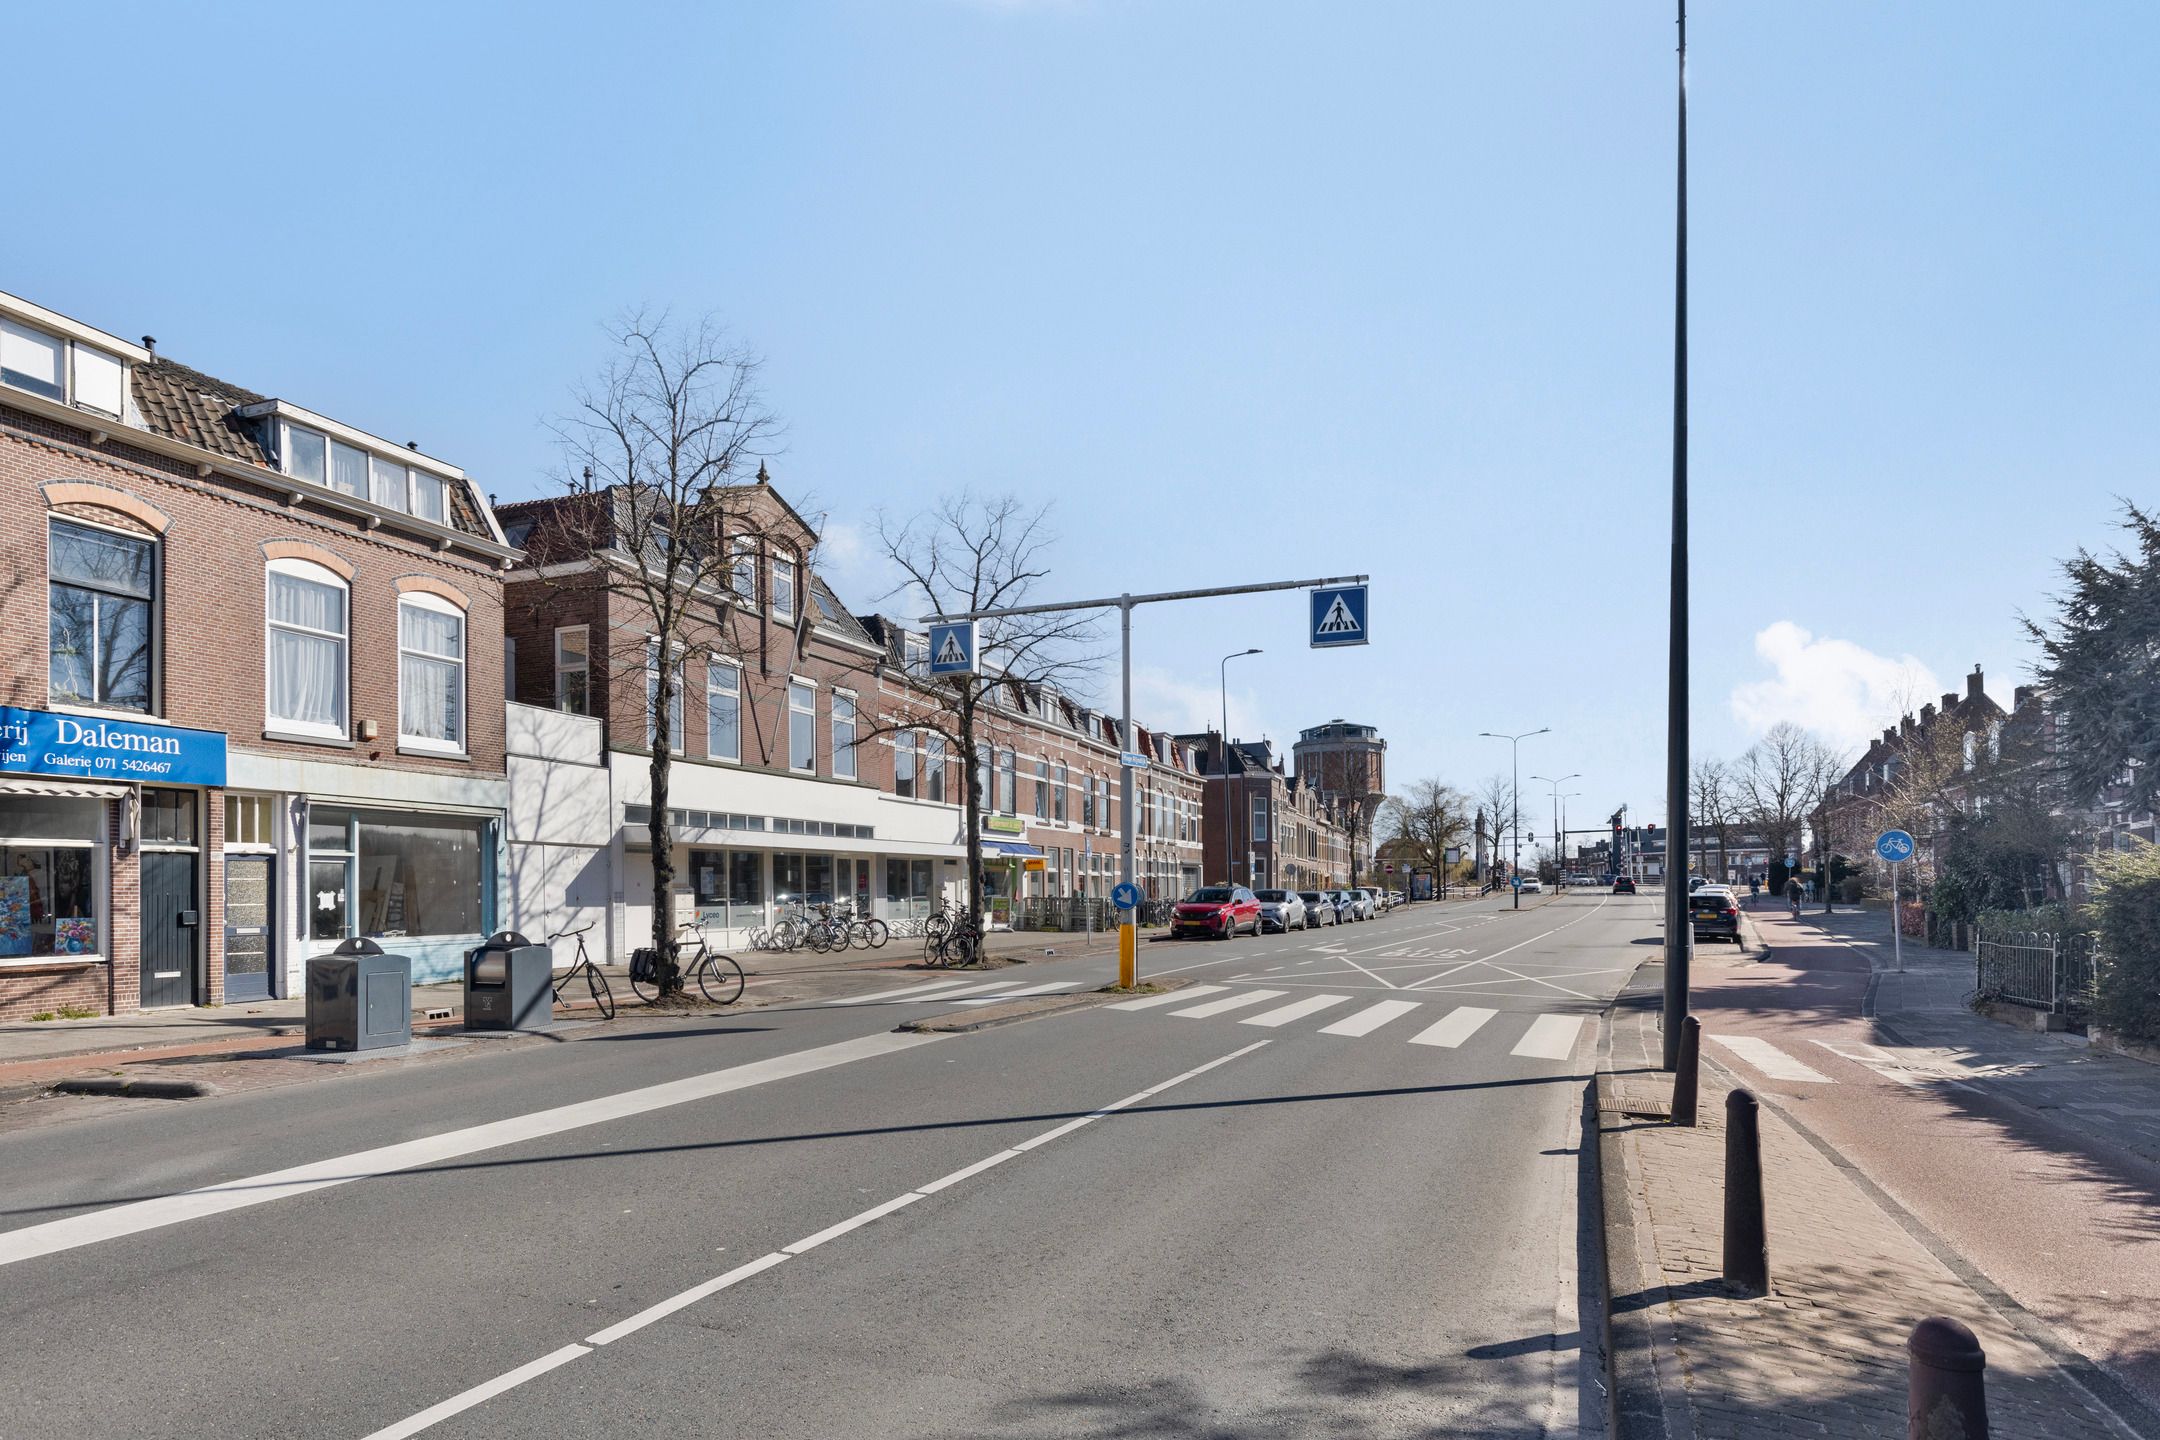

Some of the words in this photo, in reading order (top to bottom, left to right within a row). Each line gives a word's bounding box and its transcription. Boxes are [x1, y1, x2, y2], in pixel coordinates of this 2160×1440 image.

[0, 720, 28, 746] rij
[56, 718, 181, 755] Daleman
[0, 749, 27, 764] ijen
[44, 752, 92, 768] Galerie
[95, 757, 116, 770] 071
[121, 759, 171, 774] 5426467
